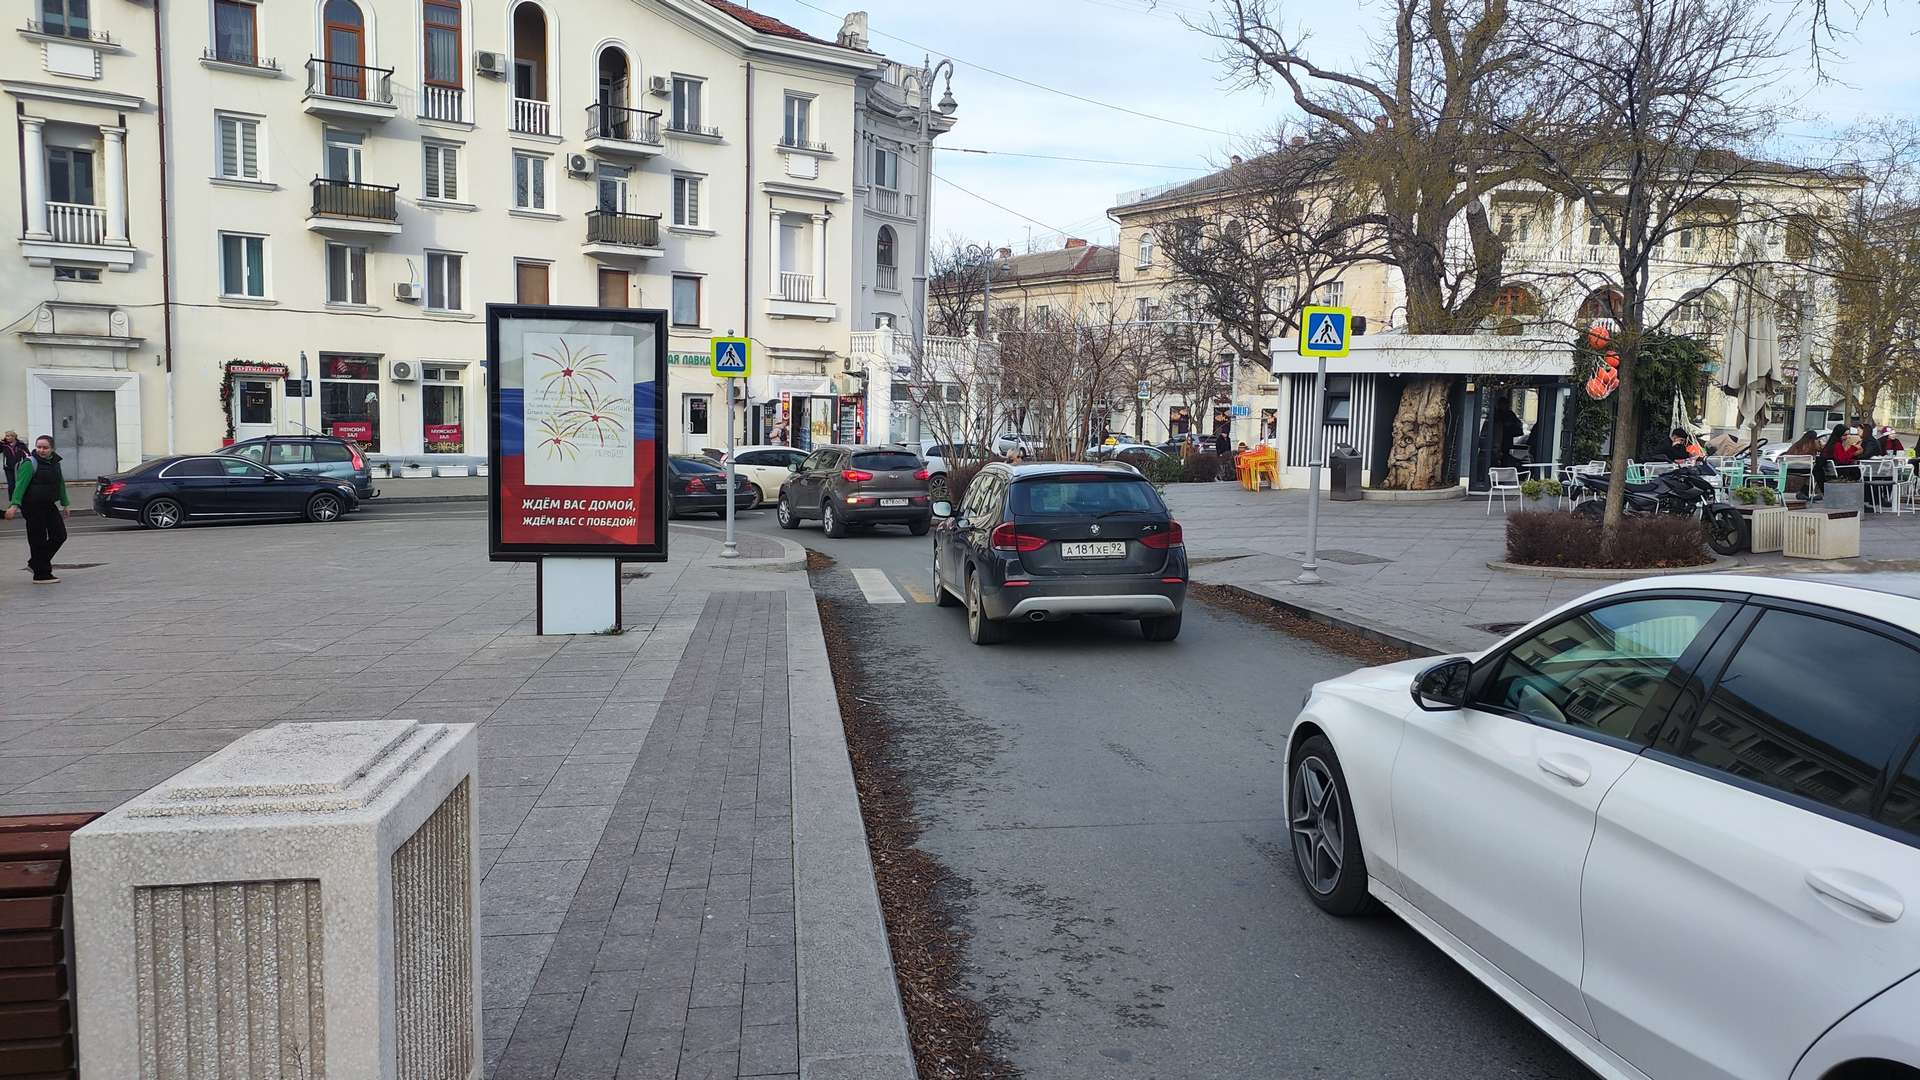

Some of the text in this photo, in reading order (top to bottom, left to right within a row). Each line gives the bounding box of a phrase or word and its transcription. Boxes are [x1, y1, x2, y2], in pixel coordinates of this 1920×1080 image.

[682, 354, 711, 366] ЛАВКА
[521, 497, 636, 512] ЖДЁМ ВАС ДОМОЙ,
[522, 514, 636, 527] ЖДЁМ ВАС С ПОБЕДОЙ!
